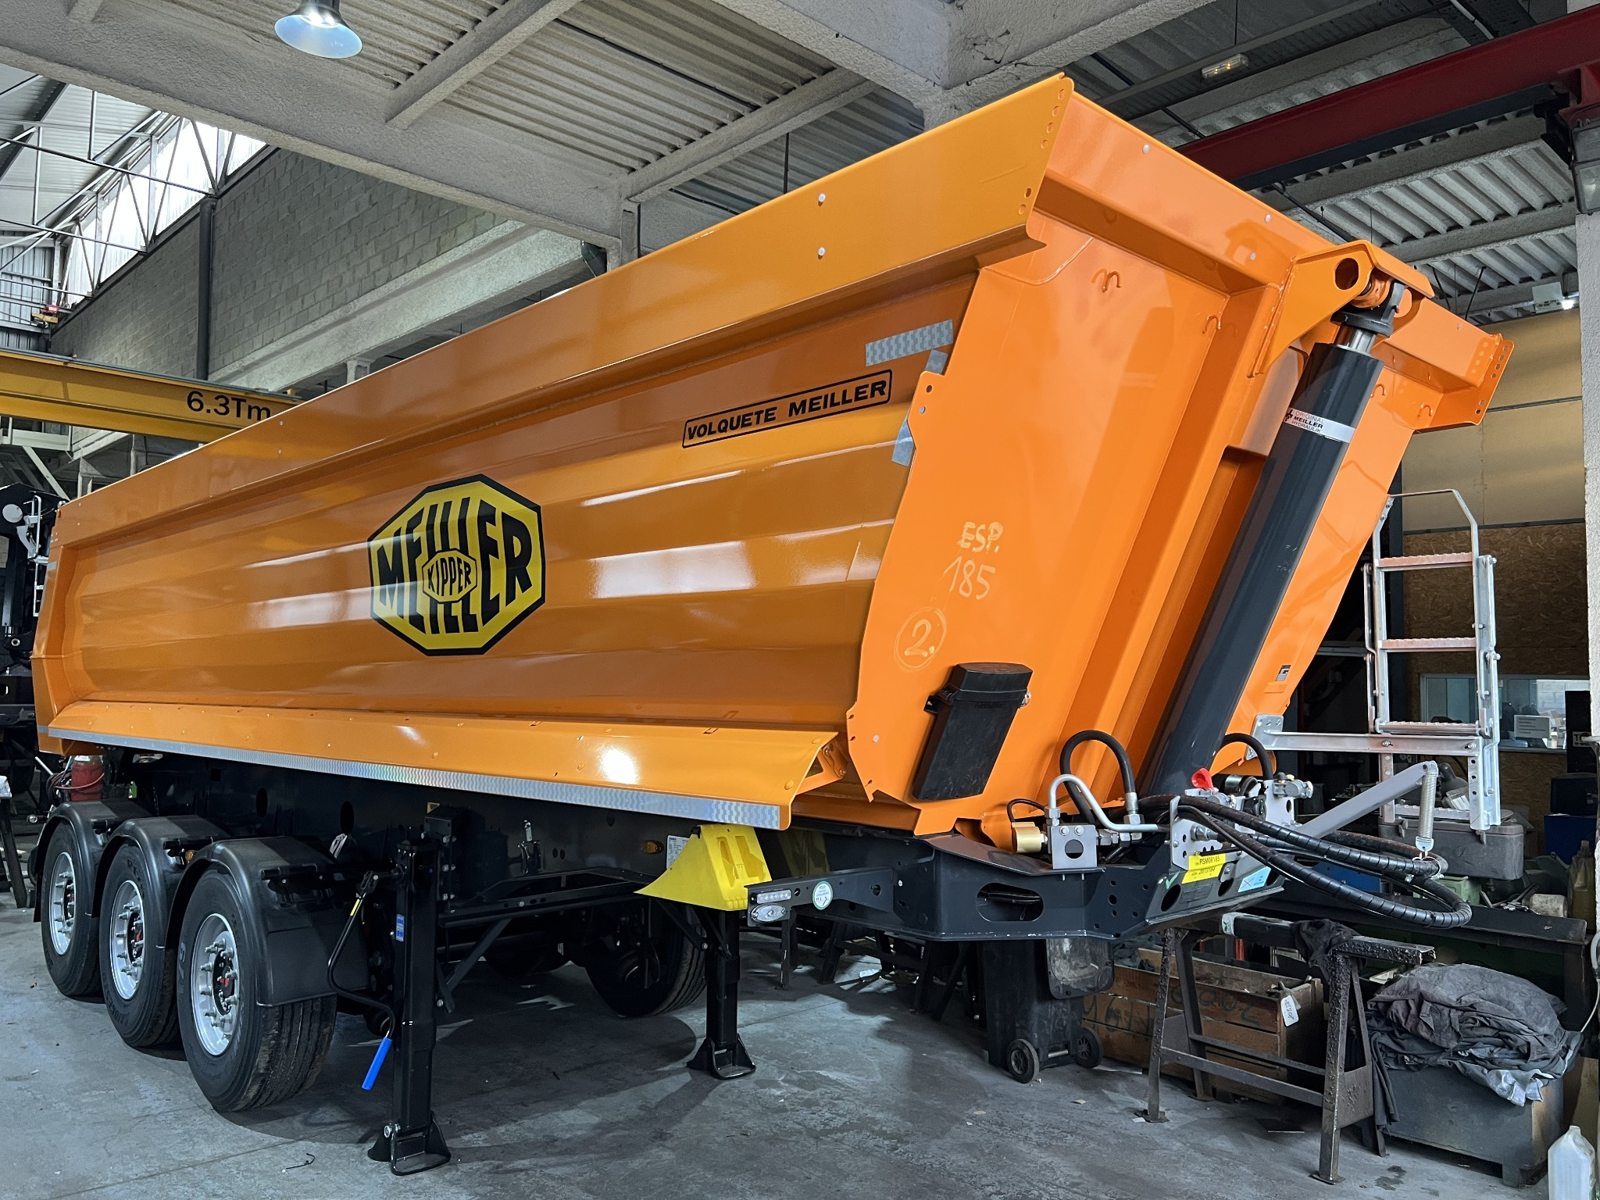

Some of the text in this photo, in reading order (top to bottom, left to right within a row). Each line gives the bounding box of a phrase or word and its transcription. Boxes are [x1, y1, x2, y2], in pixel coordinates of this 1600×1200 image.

[186, 390, 271, 421] 6.3Tm
[687, 379, 887, 440] VOLQUETE MEILLER
[1293, 415, 1324, 430] MEILLER
[376, 496, 533, 635] MEILLER
[427, 555, 472, 597] KIPPER
[943, 555, 997, 600] 185
